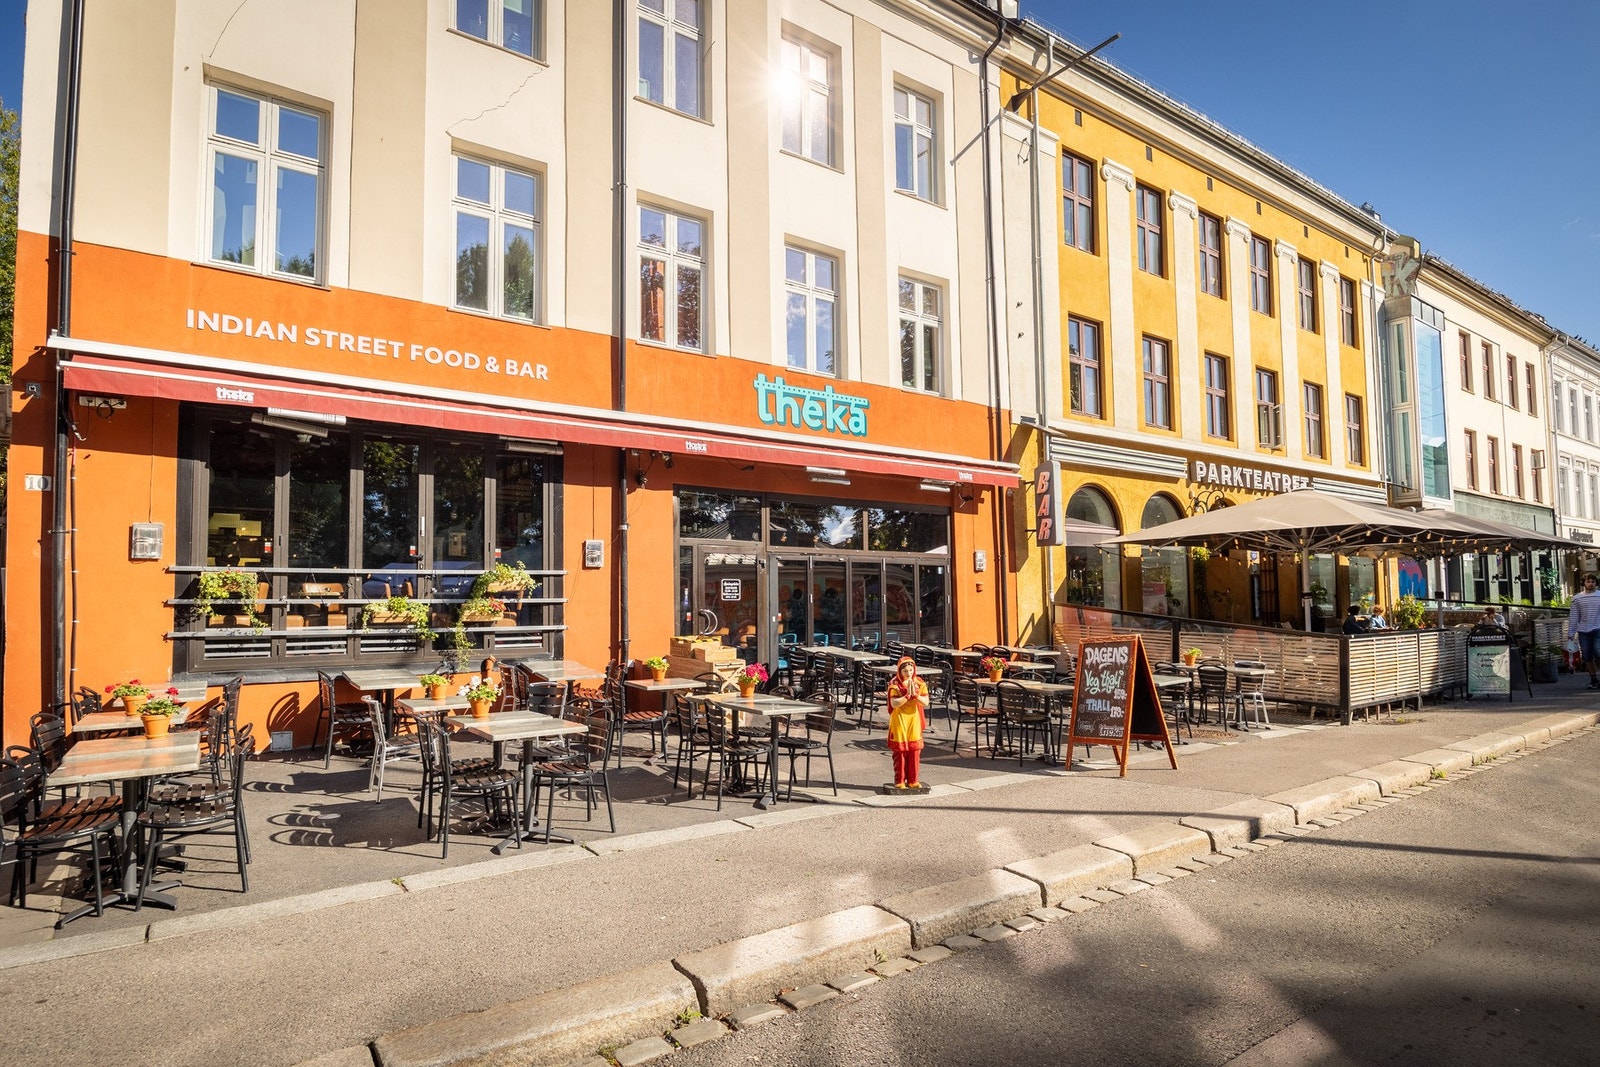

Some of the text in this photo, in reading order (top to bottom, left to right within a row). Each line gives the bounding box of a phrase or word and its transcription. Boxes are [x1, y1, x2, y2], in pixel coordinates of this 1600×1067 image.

[186, 308, 549, 381] INDIAN STREET FOOD & BAR
[753, 373, 869, 436] theka
[28, 477, 49, 489] 10
[1195, 460, 1310, 493] PARKTEATRET
[1036, 471, 1052, 541] BAR
[1084, 646, 1129, 665] DAGENS
[1084, 669, 1124, 695] Veg thali
[1086, 698, 1111, 712] THALI
